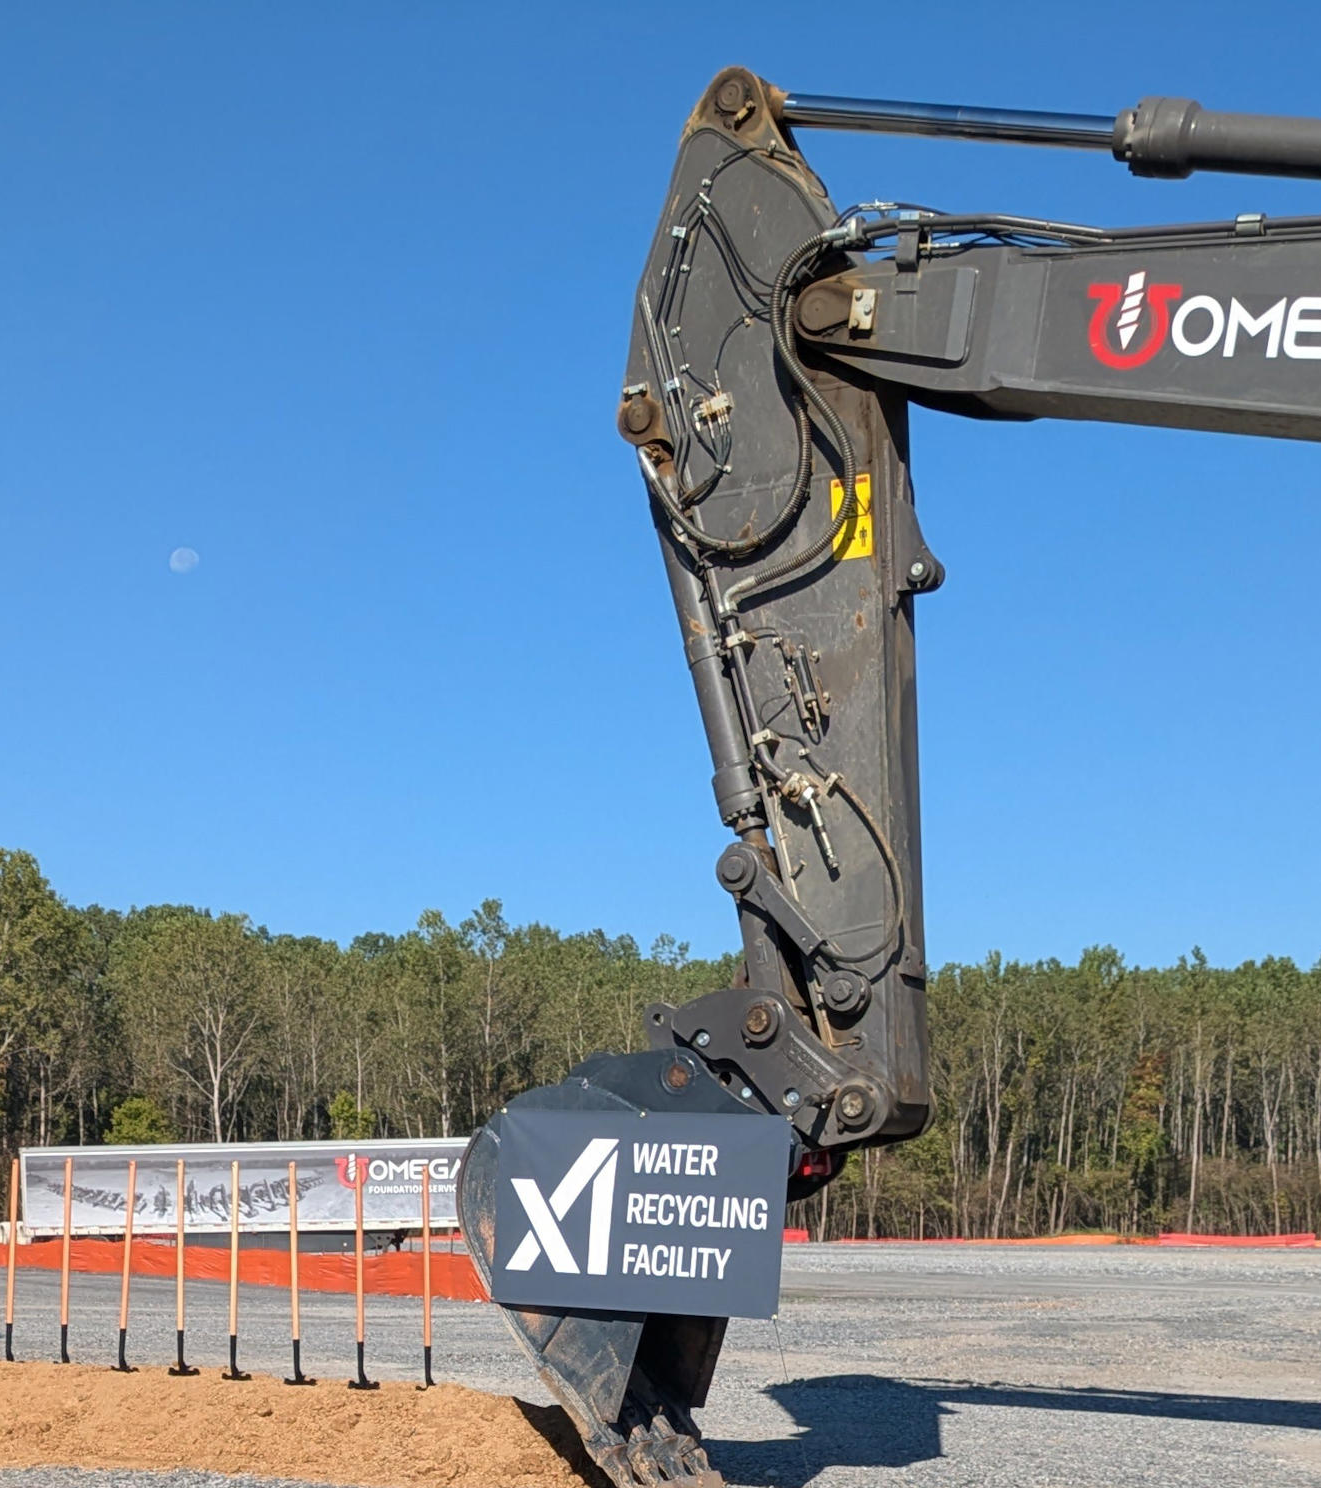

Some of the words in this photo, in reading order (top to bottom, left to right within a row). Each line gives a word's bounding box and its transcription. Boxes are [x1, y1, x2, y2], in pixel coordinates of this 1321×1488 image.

[632, 1142, 719, 1176] WATER
[428, 1183, 457, 1193] SERVIC
[626, 1193, 768, 1230] RECYCLING
[622, 1243, 732, 1280] FACILITY
